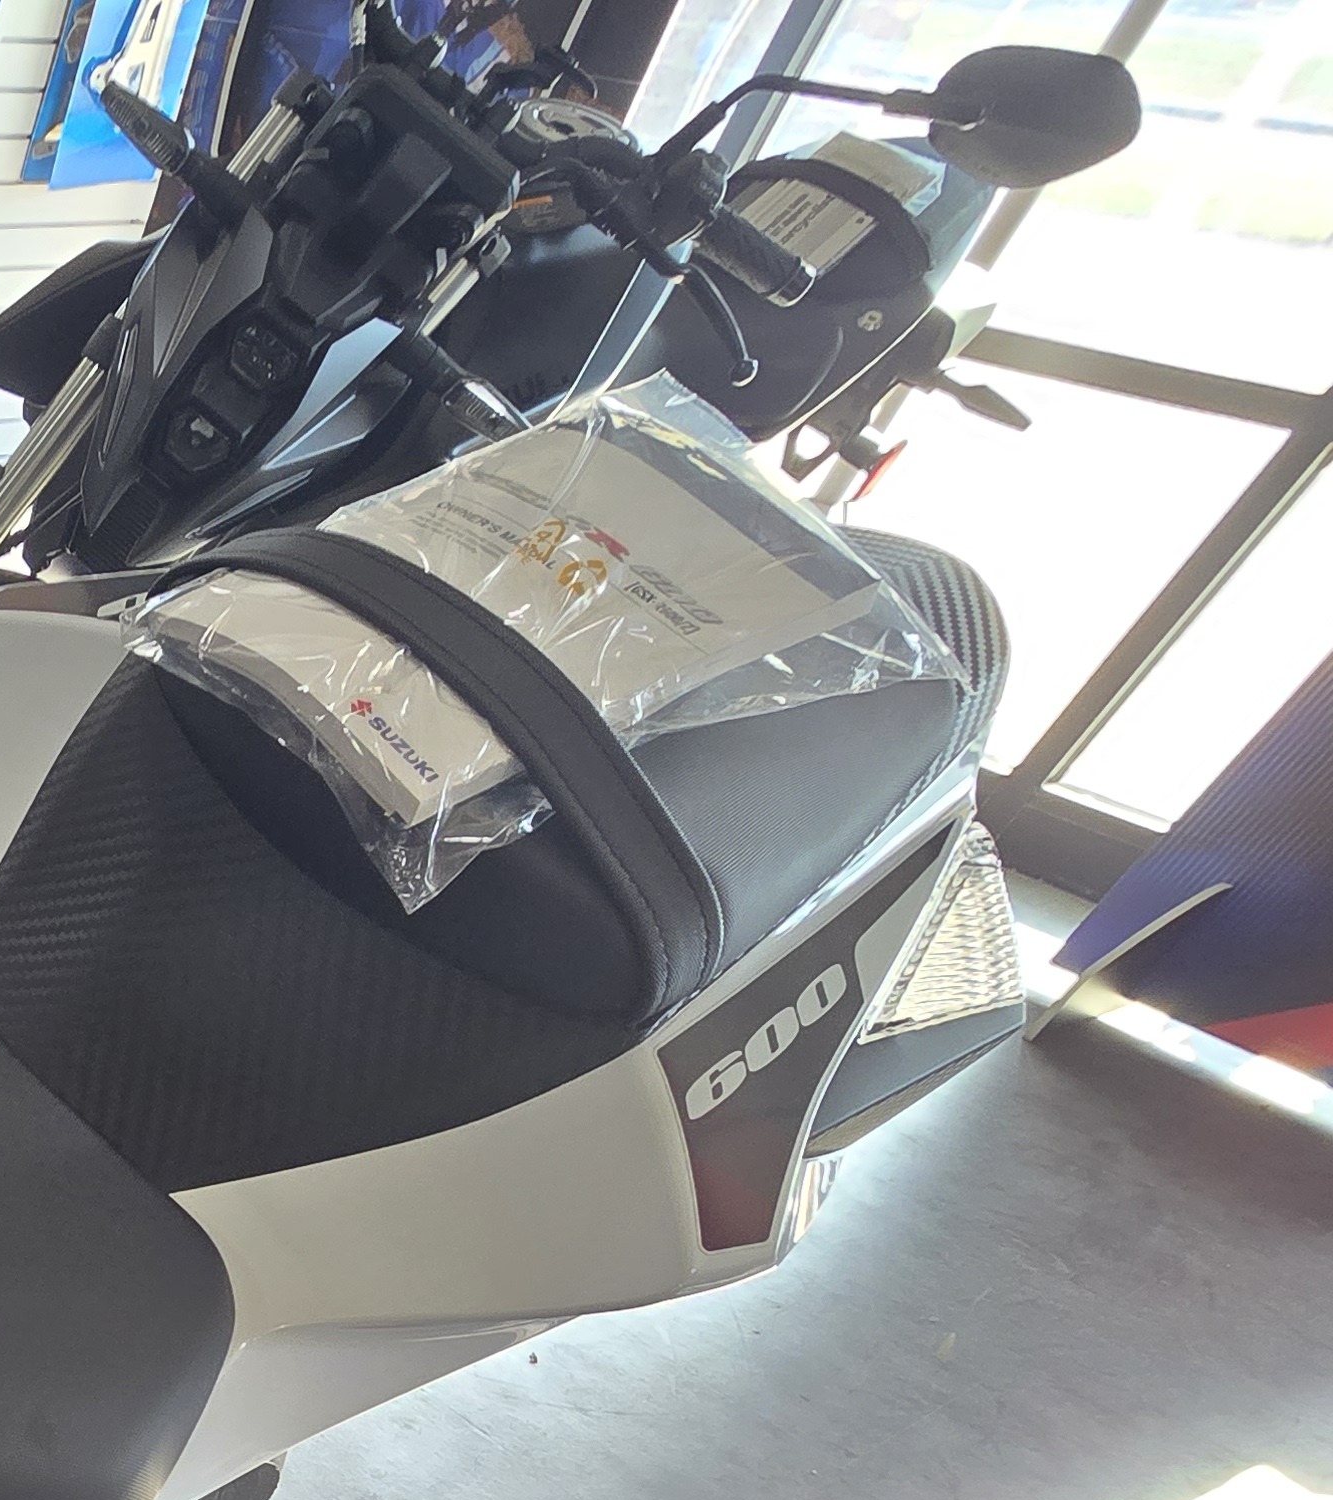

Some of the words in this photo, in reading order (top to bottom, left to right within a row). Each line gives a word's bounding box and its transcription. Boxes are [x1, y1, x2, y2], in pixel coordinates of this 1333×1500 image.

[436, 501, 503, 541] OWNER'S
[368, 716, 439, 782] SUZUKI
[685, 963, 847, 1120] 600
